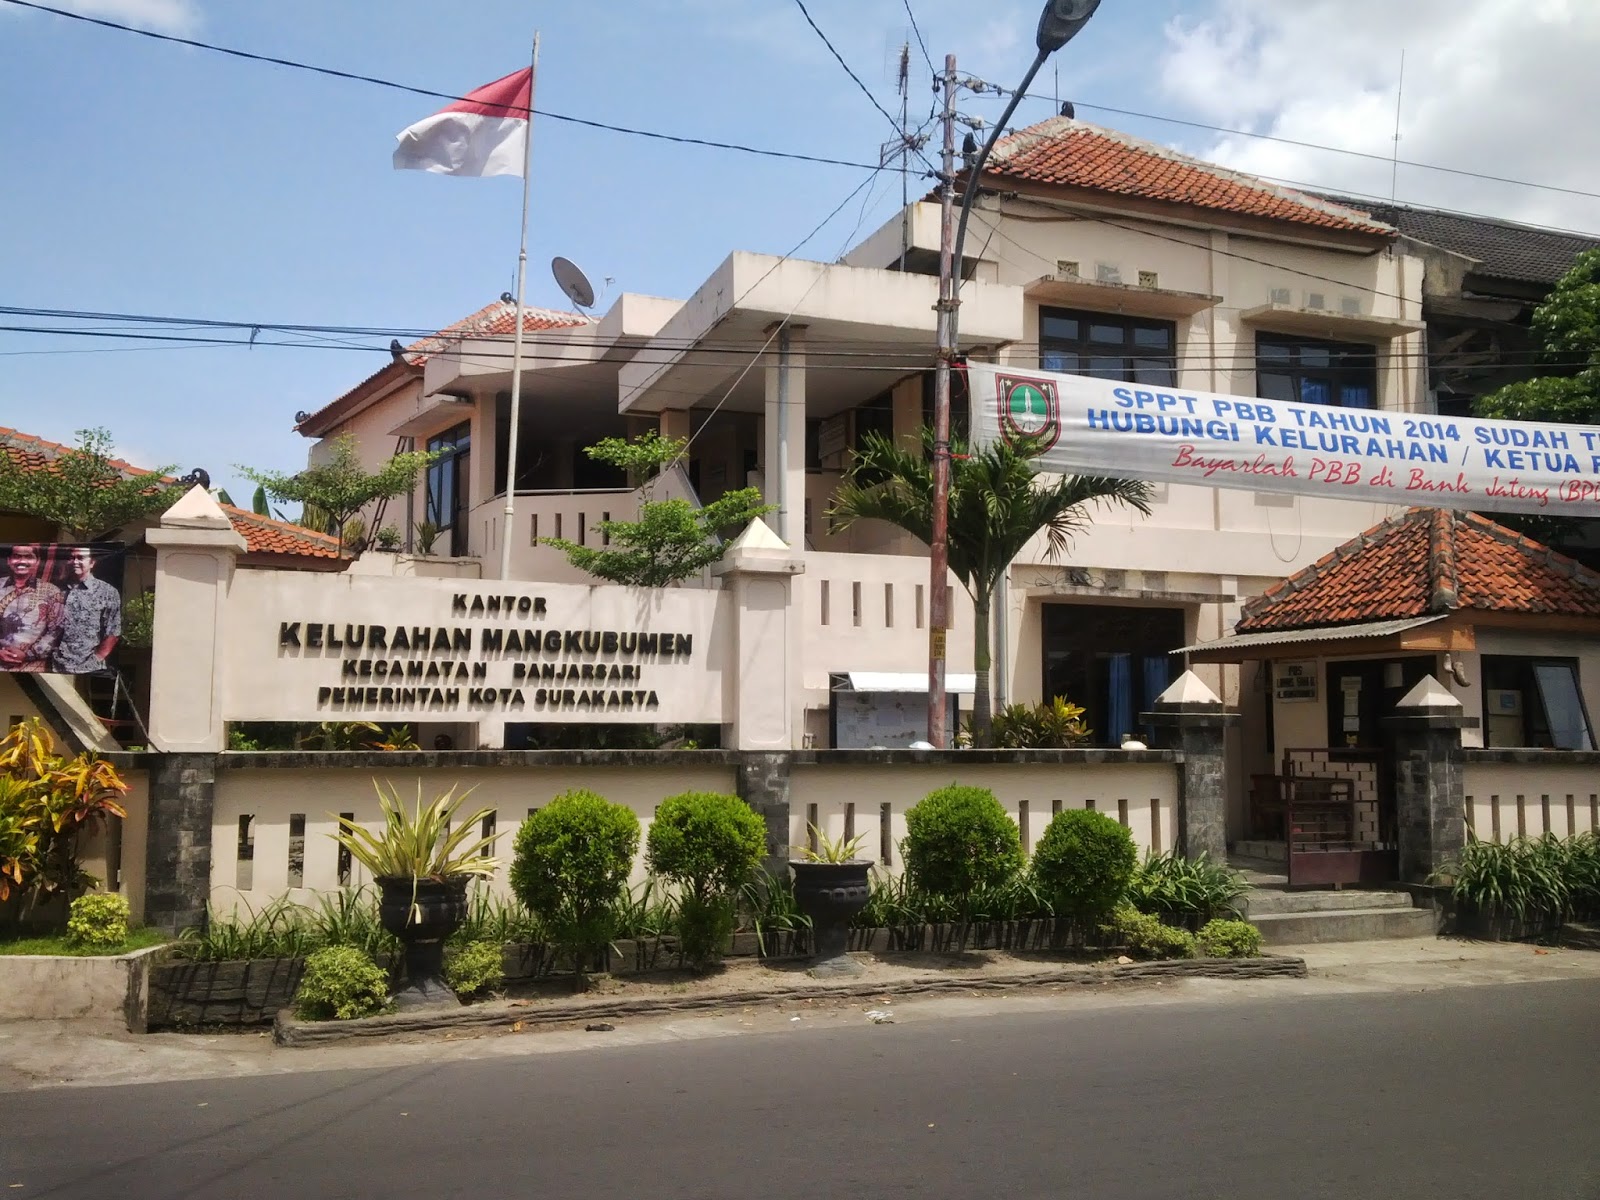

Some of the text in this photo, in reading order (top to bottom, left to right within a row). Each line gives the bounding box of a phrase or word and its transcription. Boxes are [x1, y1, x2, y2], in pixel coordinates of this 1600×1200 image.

[1113, 388, 1600, 451] SPPT PBB TAHUN 2014 SUDAH T
[1087, 408, 1240, 442] HUBUNGI
[1254, 425, 1448, 462] KELURAHAN
[1461, 445, 1470, 467] /
[1484, 448, 1581, 474] KETUA
[1171, 444, 1299, 478] Bayarlah
[1308, 457, 1362, 486] PBB
[1369, 465, 1396, 488] di
[1405, 468, 1472, 494] Bank
[1485, 475, 1549, 507] Jateng
[453, 593, 547, 613] KANTOR
[280, 621, 693, 655] KELURAHAN MANGKUBUMEN
[342, 659, 640, 680] KECAMATAN BANJARSARI
[318, 687, 660, 706] PEMERINTAH KOTA SURAKARTA
